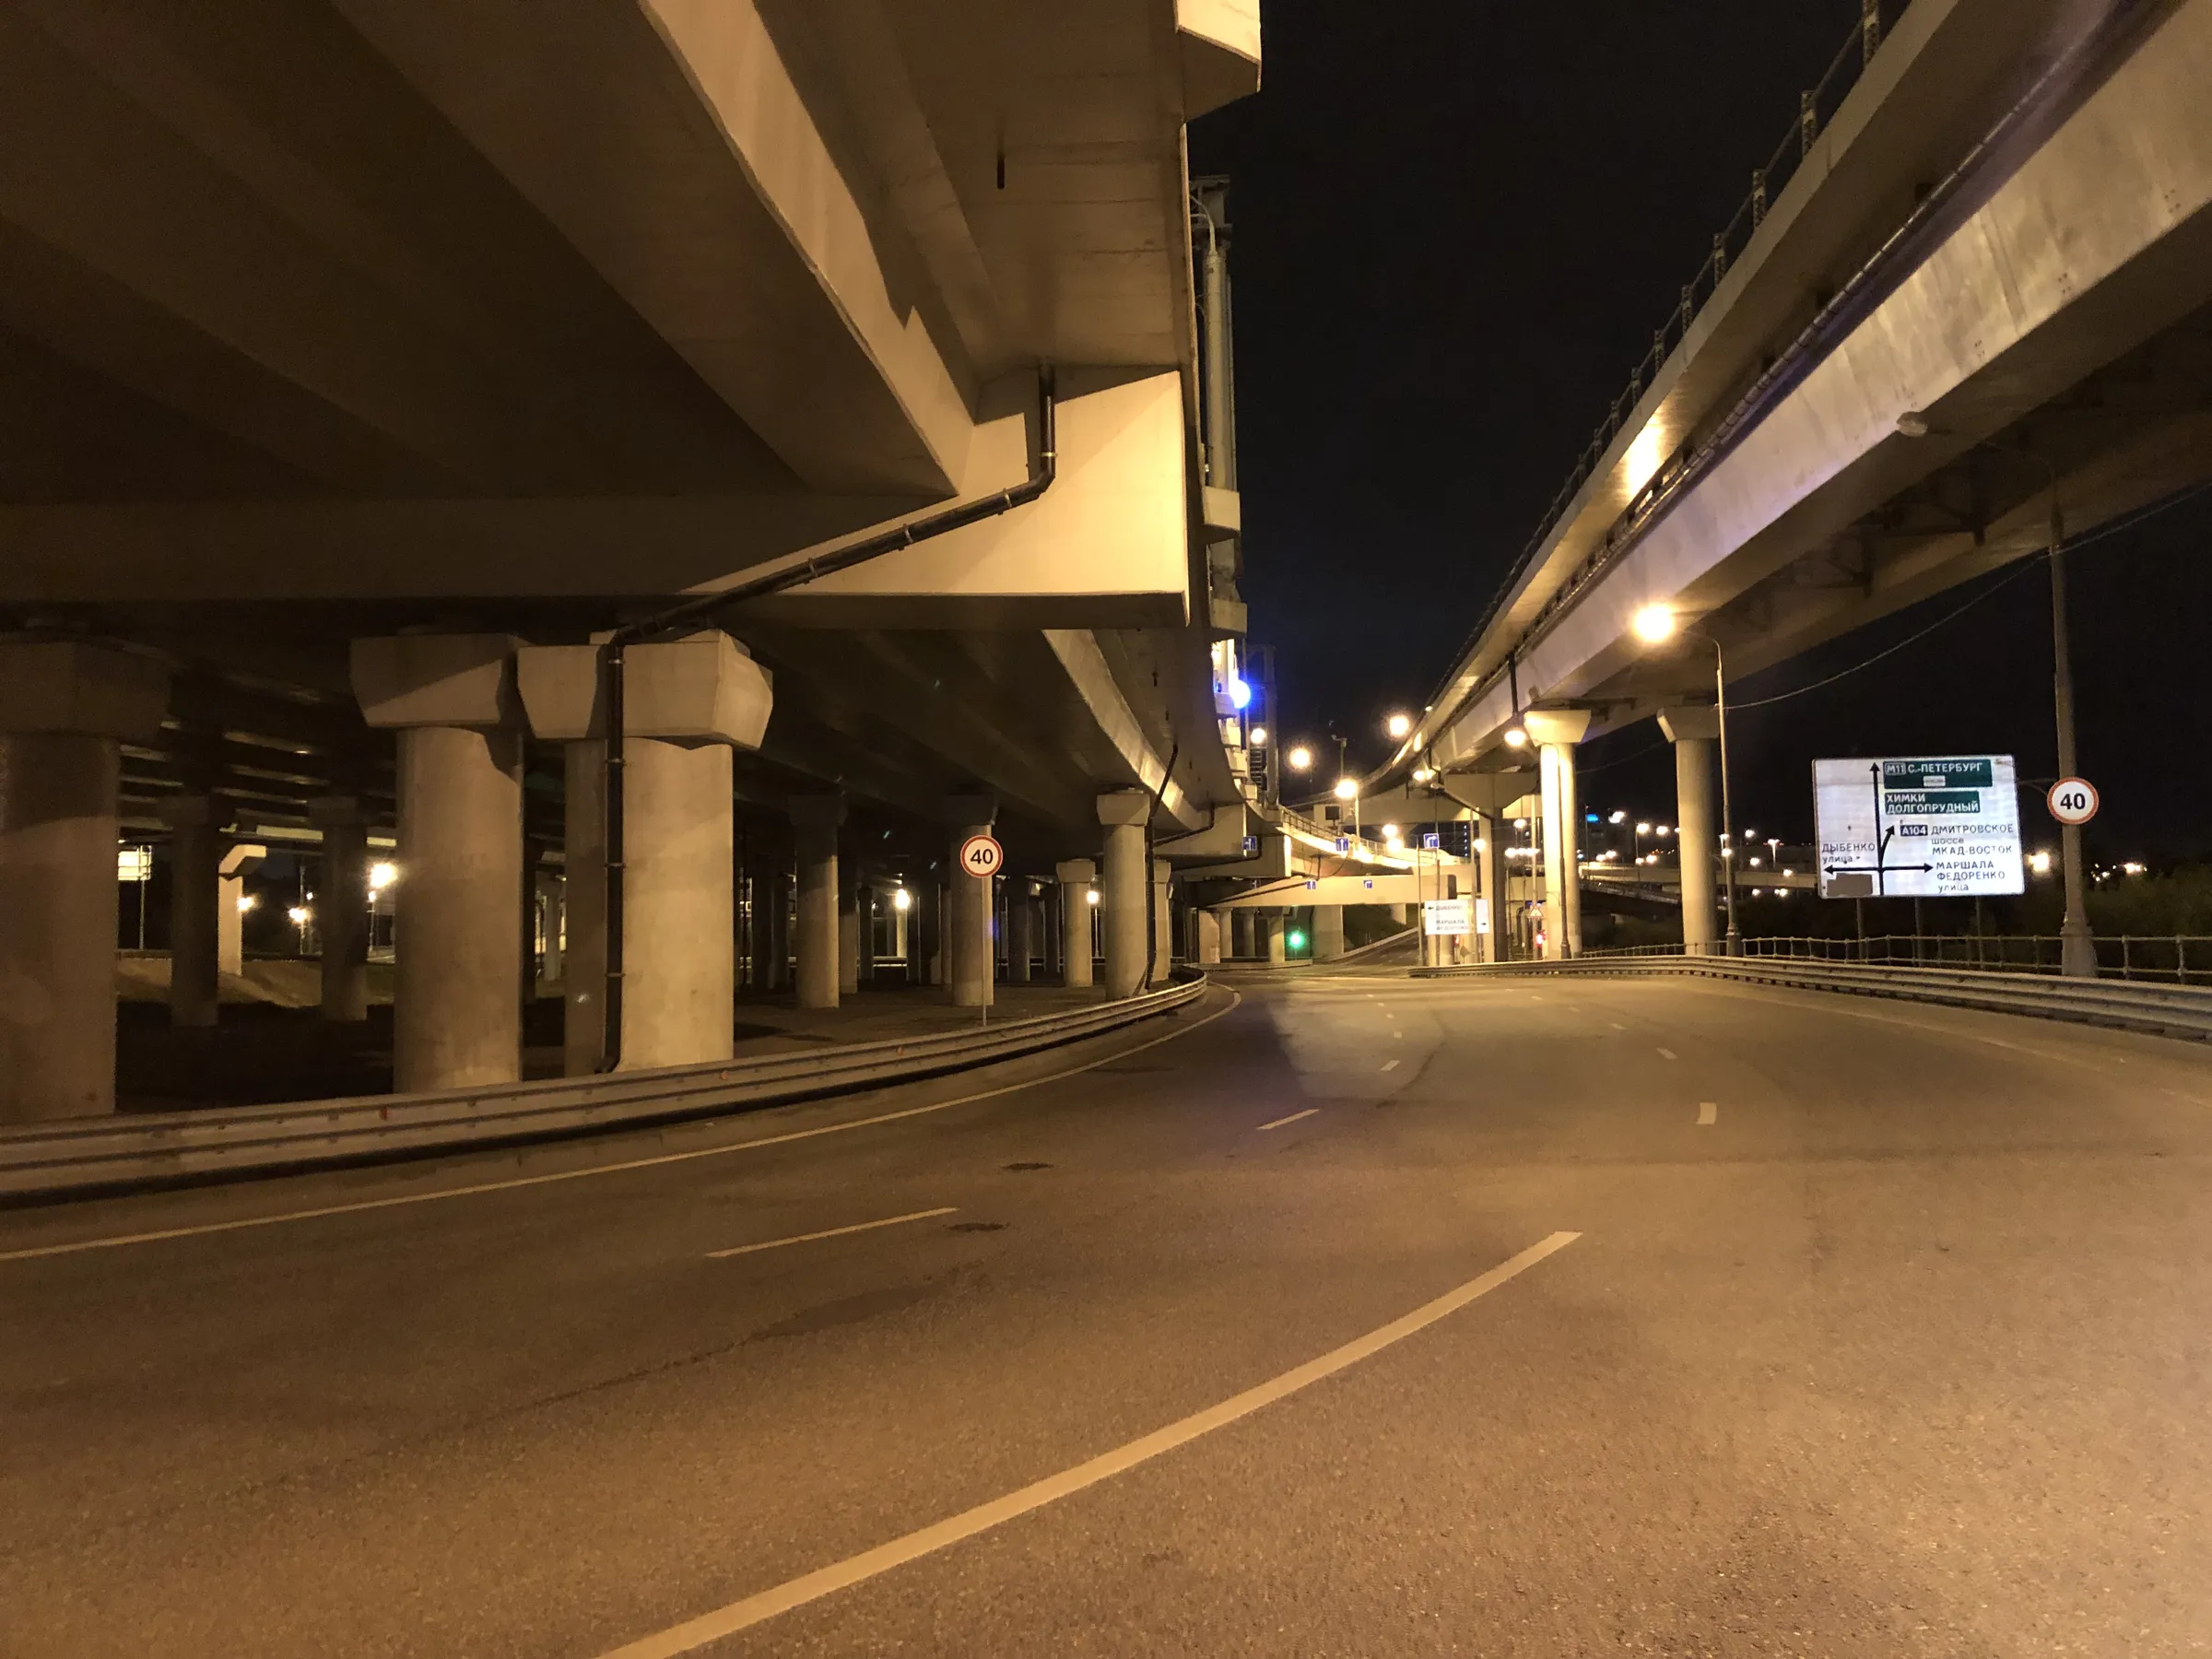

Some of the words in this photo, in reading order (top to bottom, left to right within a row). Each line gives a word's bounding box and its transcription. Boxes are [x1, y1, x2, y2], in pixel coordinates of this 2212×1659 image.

[1887, 794, 1925, 803] ХИМКИ
[2060, 793, 2086, 810] 40
[1887, 800, 1979, 815] ДОЛГОПРУДНЫЙ
[1931, 824, 2014, 835] ДМИТРОВСКОЕ
[1931, 837, 1964, 845] шоссе
[1821, 842, 1876, 853] ДЫБЕНКО
[1932, 845, 2013, 855] МКАД-ВОСТОК
[970, 848, 994, 865] 40
[1822, 855, 1853, 865] улица
[1936, 860, 1994, 870] МАРШАЛА
[1936, 871, 2006, 881] ФЕДОРЕНКО
[1937, 884, 1970, 893] улица
